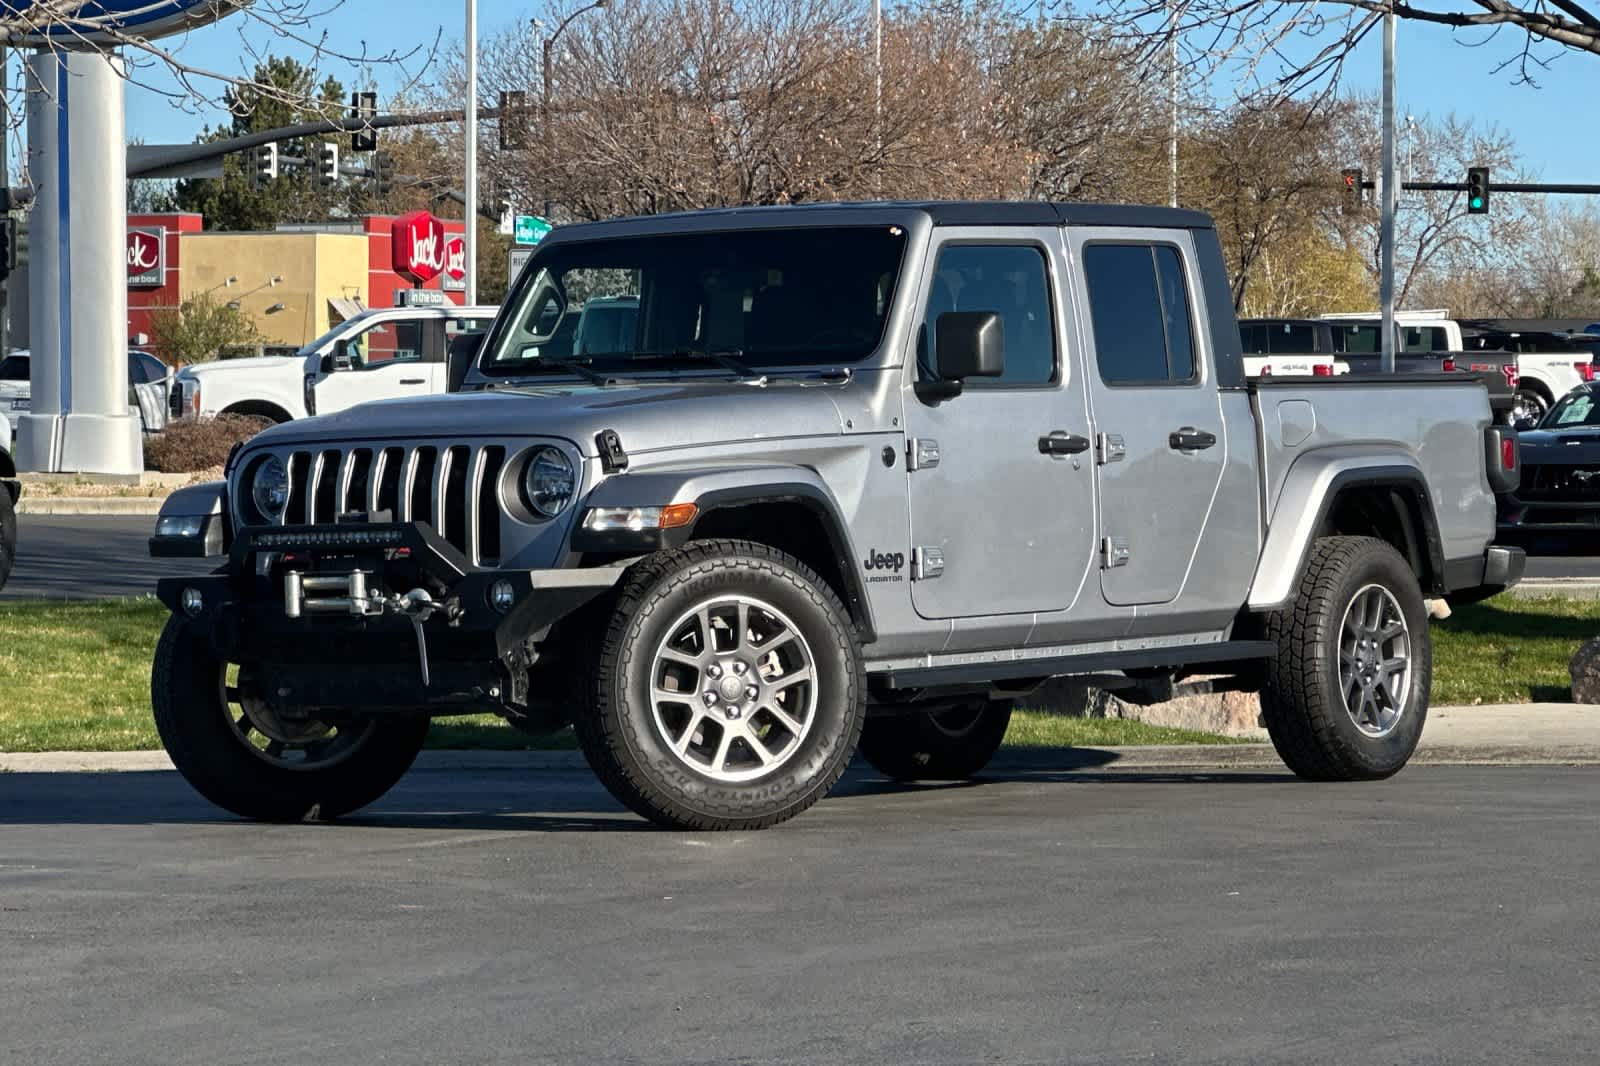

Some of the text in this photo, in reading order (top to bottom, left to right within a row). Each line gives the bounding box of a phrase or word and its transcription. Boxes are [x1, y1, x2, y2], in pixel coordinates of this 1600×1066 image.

[127, 236, 158, 268] ck
[409, 222, 444, 270] Jack
[513, 256, 526, 266] RIG
[411, 291, 418, 302] in
[419, 291, 430, 302] the
[864, 549, 904, 573] Jeep
[683, 571, 772, 599] IRONMAN
[704, 775, 795, 800] COUNTRY
